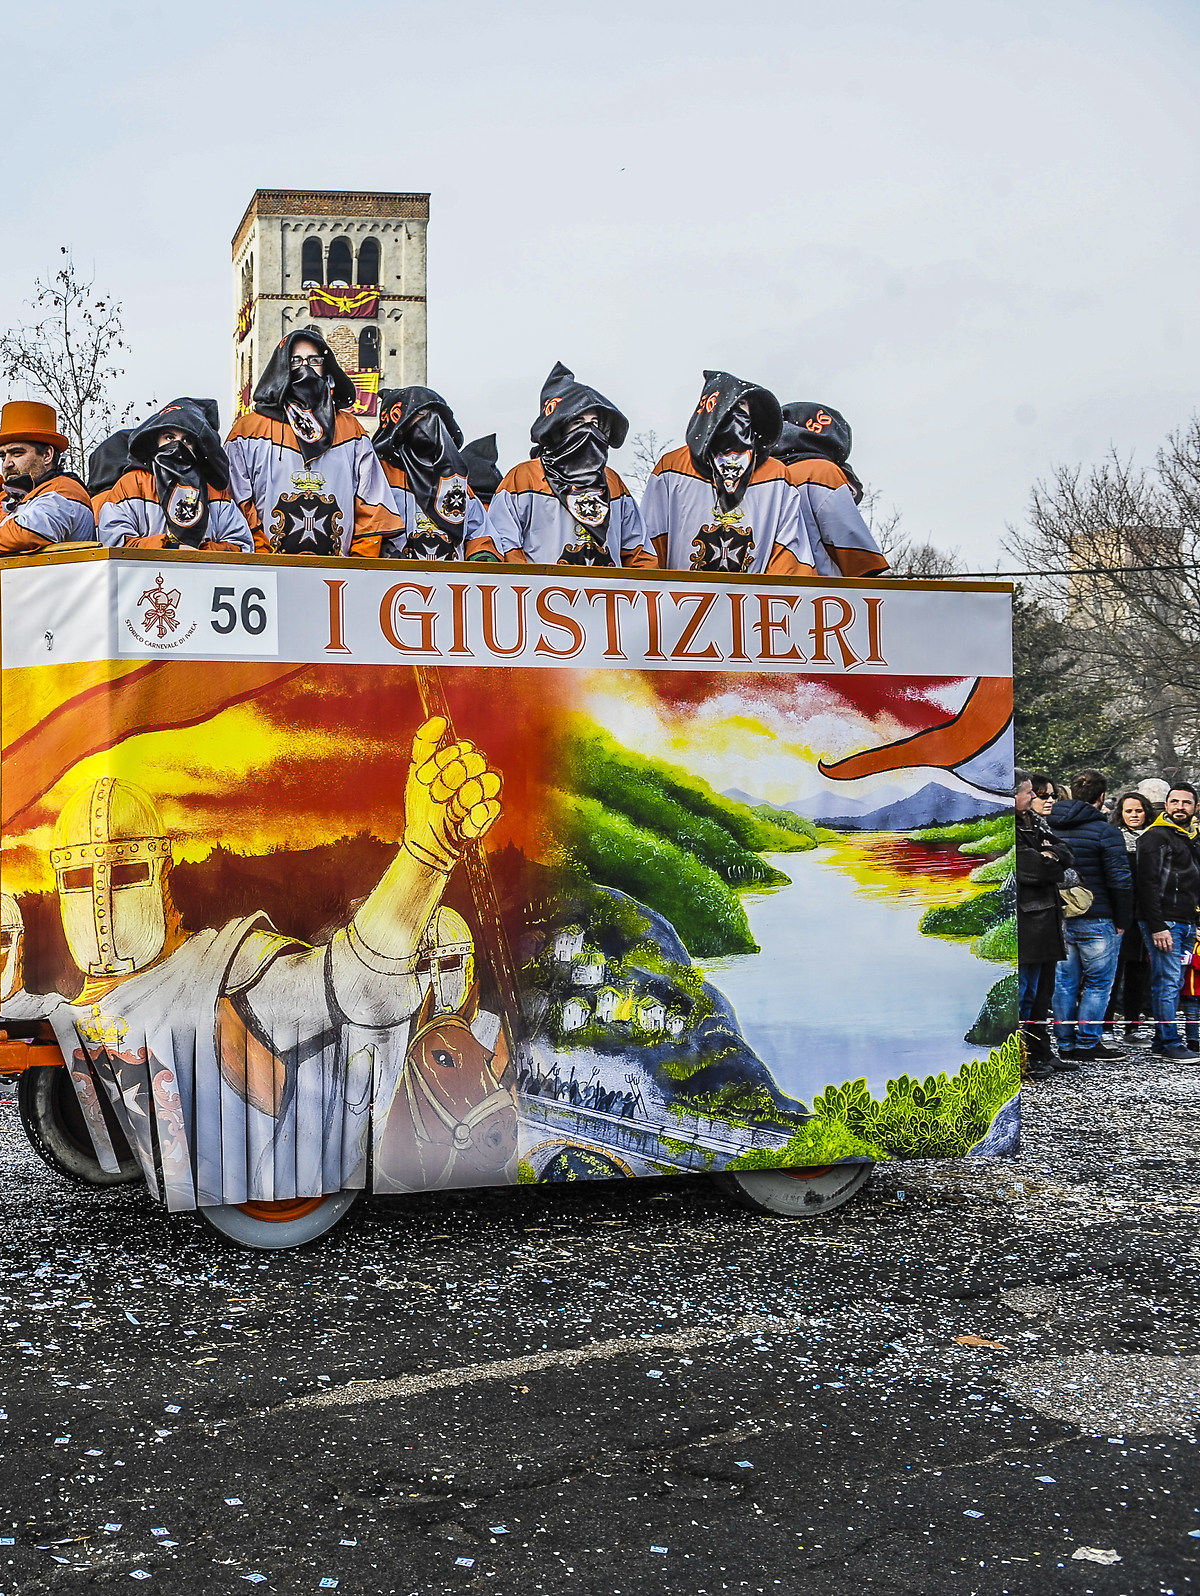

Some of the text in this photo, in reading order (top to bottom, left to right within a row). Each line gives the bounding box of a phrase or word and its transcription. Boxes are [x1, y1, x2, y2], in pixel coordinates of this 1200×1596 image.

[380, 401, 403, 428] 56
[805, 409, 833, 434] 56
[210, 586, 268, 636] 56
[322, 578, 892, 671] I GIUSTIZIERI
[124, 618, 145, 643] STORICO
[144, 640, 179, 650] CARNEVALE
[179, 637, 186, 645] DI
